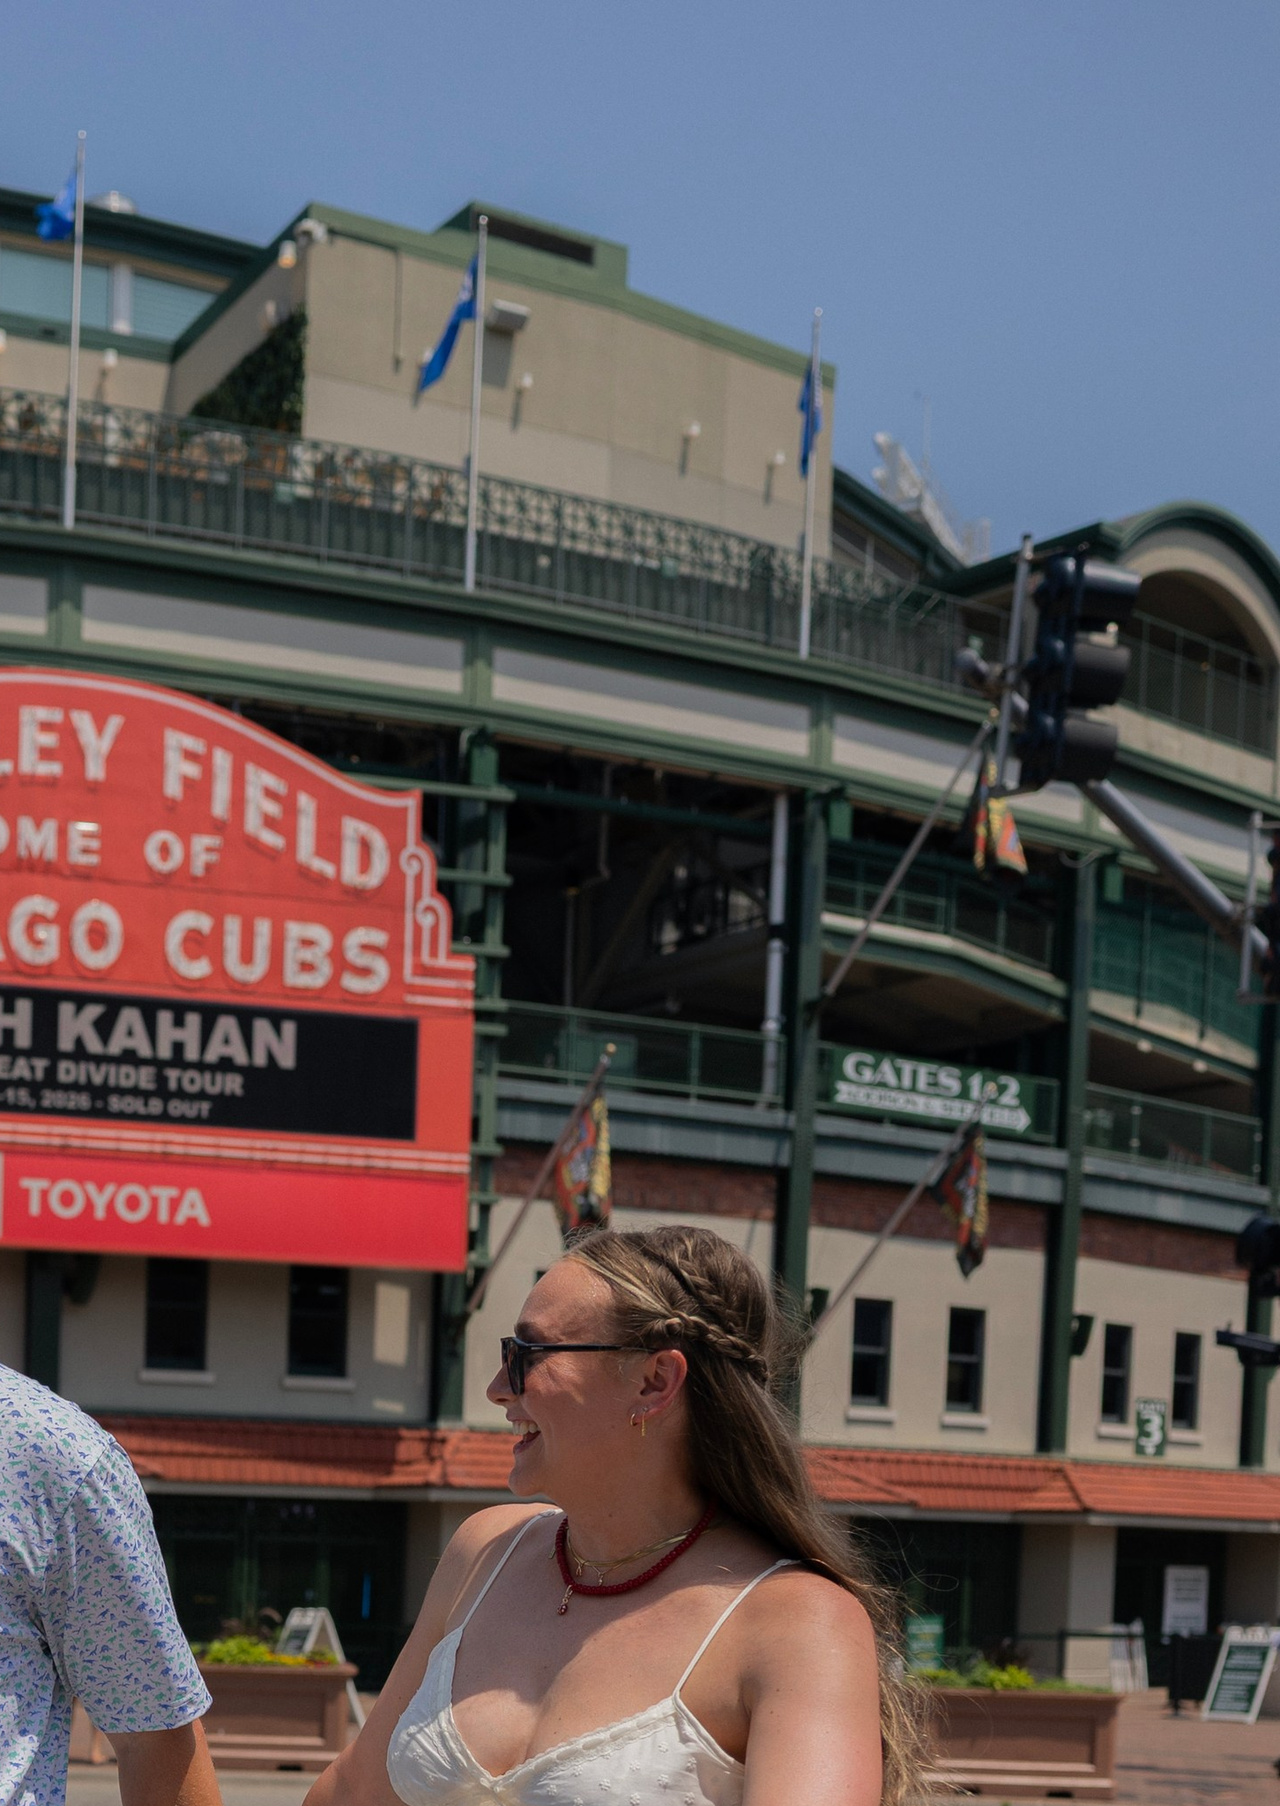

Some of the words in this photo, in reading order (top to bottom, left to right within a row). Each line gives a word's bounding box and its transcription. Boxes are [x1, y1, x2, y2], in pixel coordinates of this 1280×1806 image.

[162, 728, 391, 892] FIELD
[144, 830, 224, 877] OF
[165, 911, 392, 994] CUBS
[57, 1002, 298, 1070] KAHAN
[56, 1060, 158, 1091] DIVIDE
[164, 1068, 245, 1097] TOUR
[842, 1052, 962, 1097] GATES
[107, 1094, 164, 1116] SOLD
[167, 1099, 213, 1119] OUT
[20, 1178, 211, 1227] TOYOTA
[1138, 1411, 1164, 1446] 3
